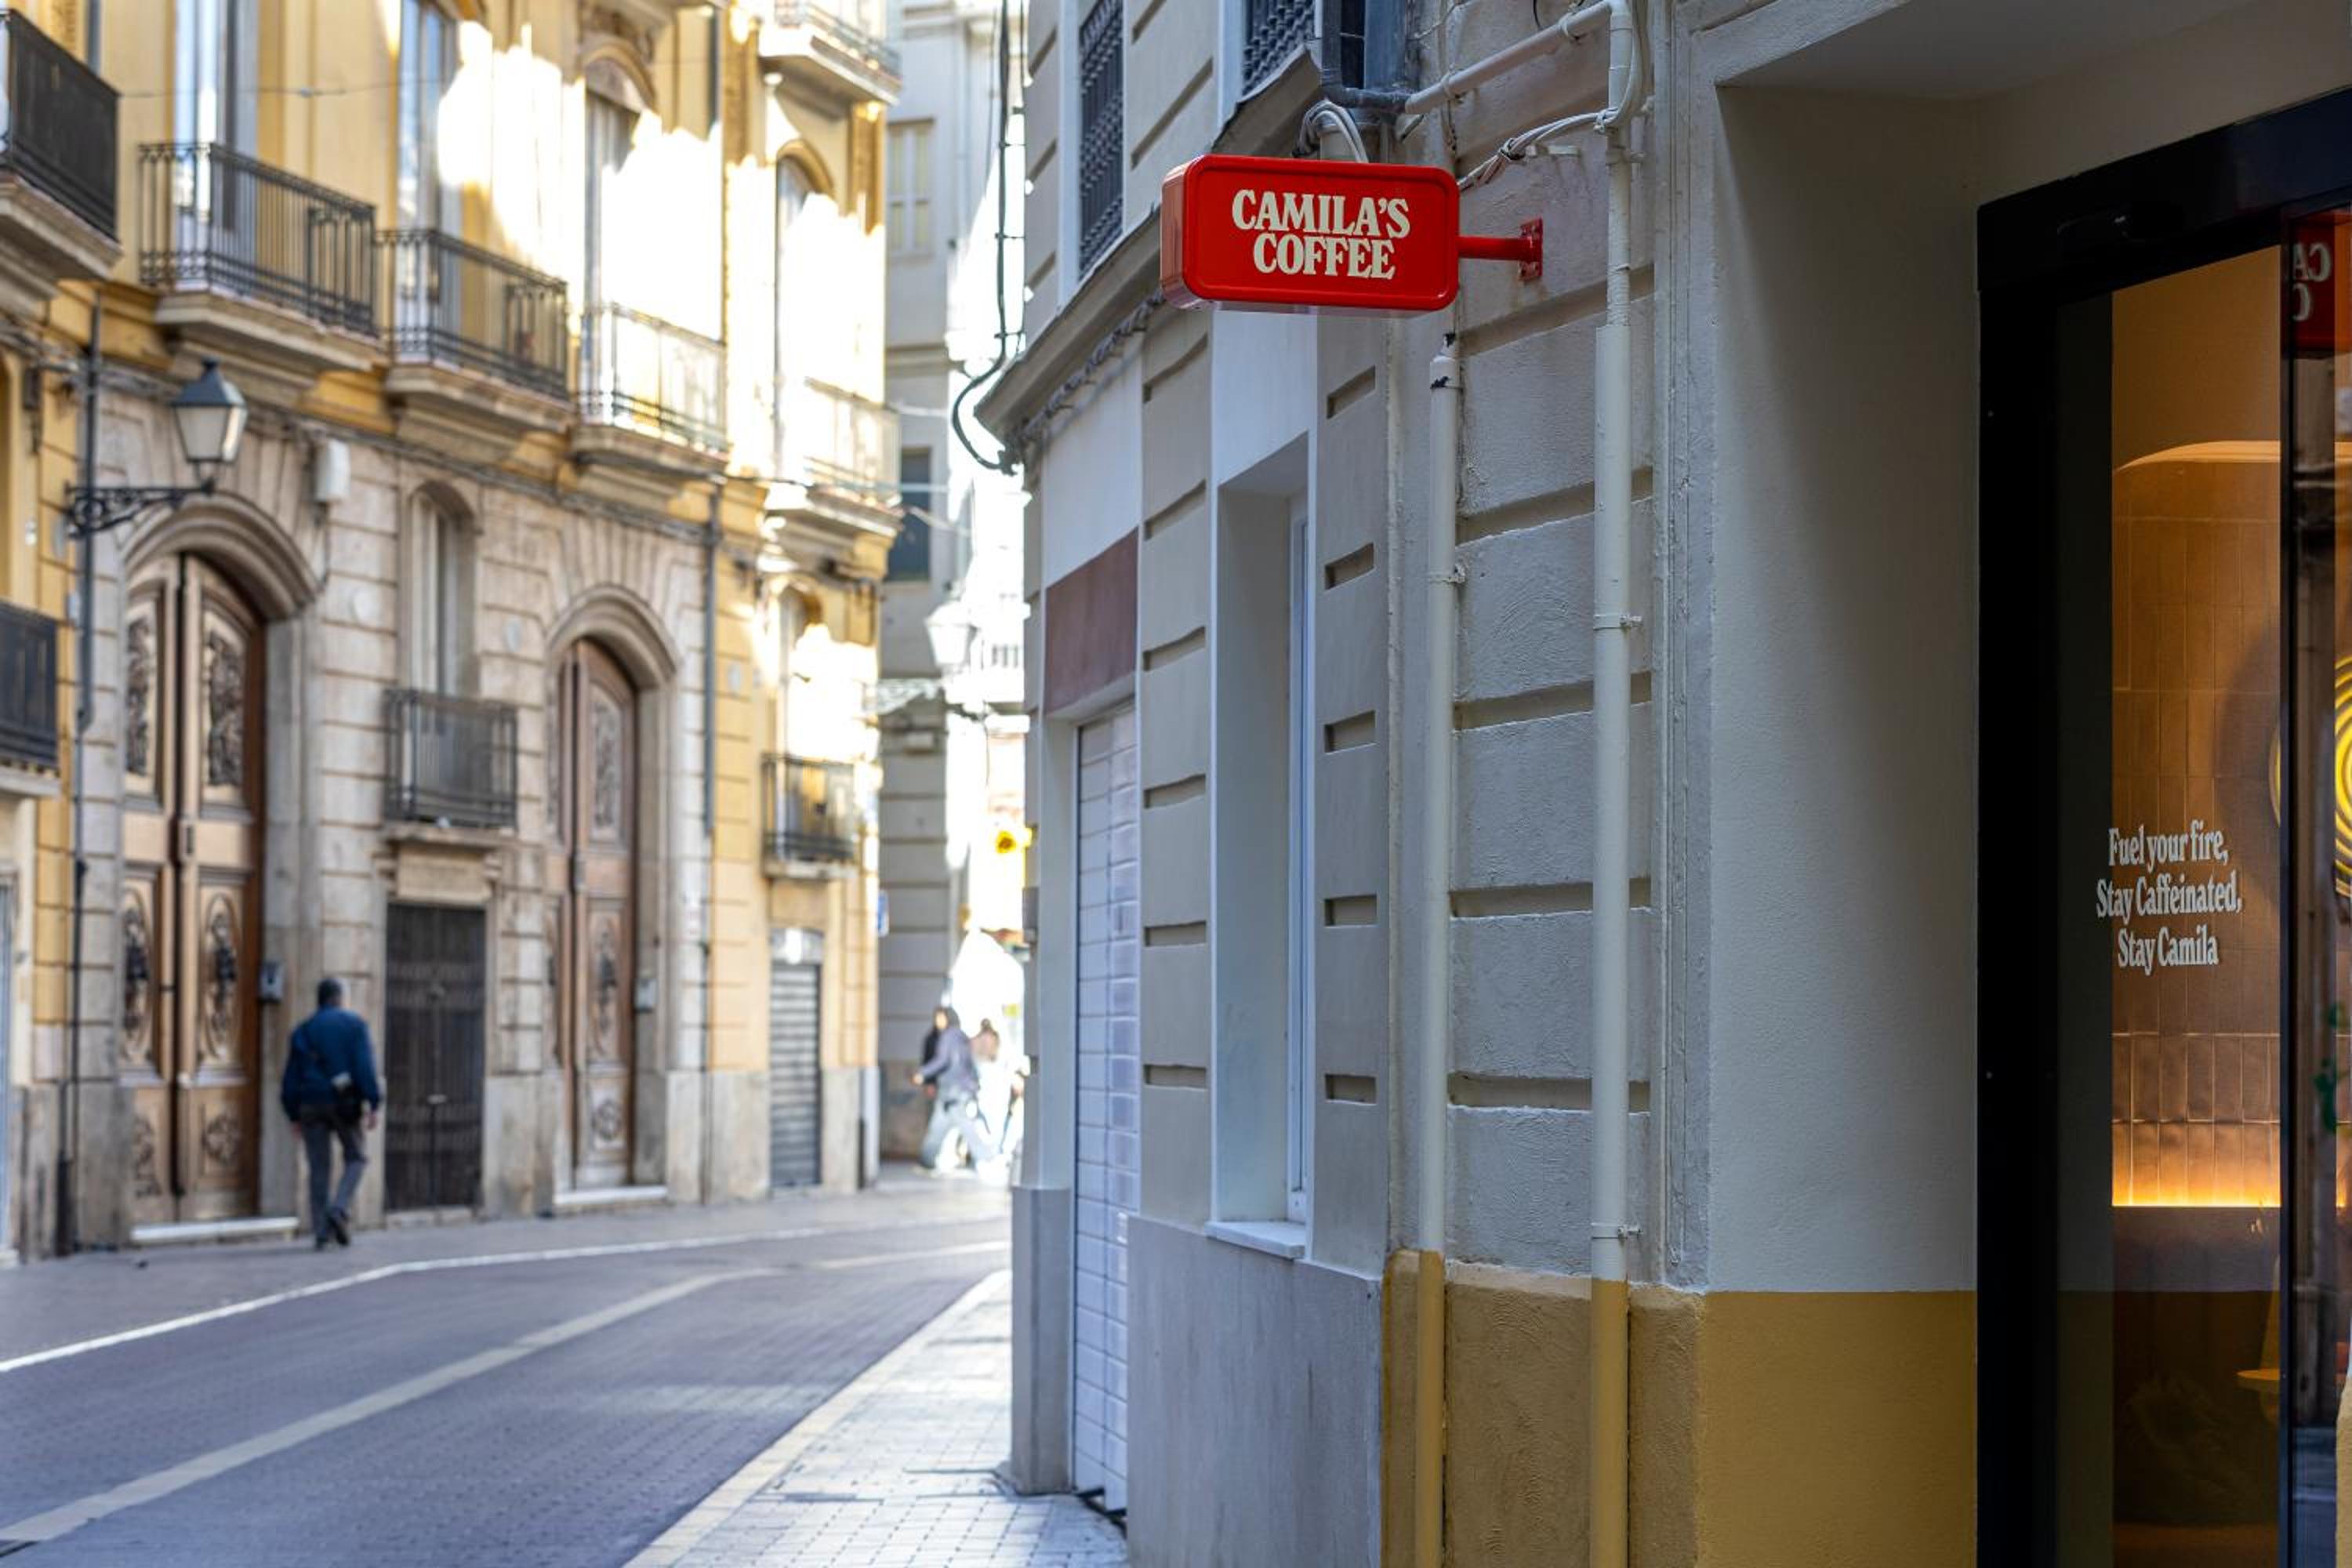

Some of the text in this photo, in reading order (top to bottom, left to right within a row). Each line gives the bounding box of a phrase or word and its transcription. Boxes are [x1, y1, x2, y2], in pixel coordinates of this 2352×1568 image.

[1232, 190, 1410, 238] CAMILA'S
[1253, 233, 1395, 279] COFFEE
[2108, 819, 2229, 873] Fuel your fire,
[2096, 869, 2242, 925] Stay Caffeinated,
[2118, 924, 2220, 975] Stay Camila
